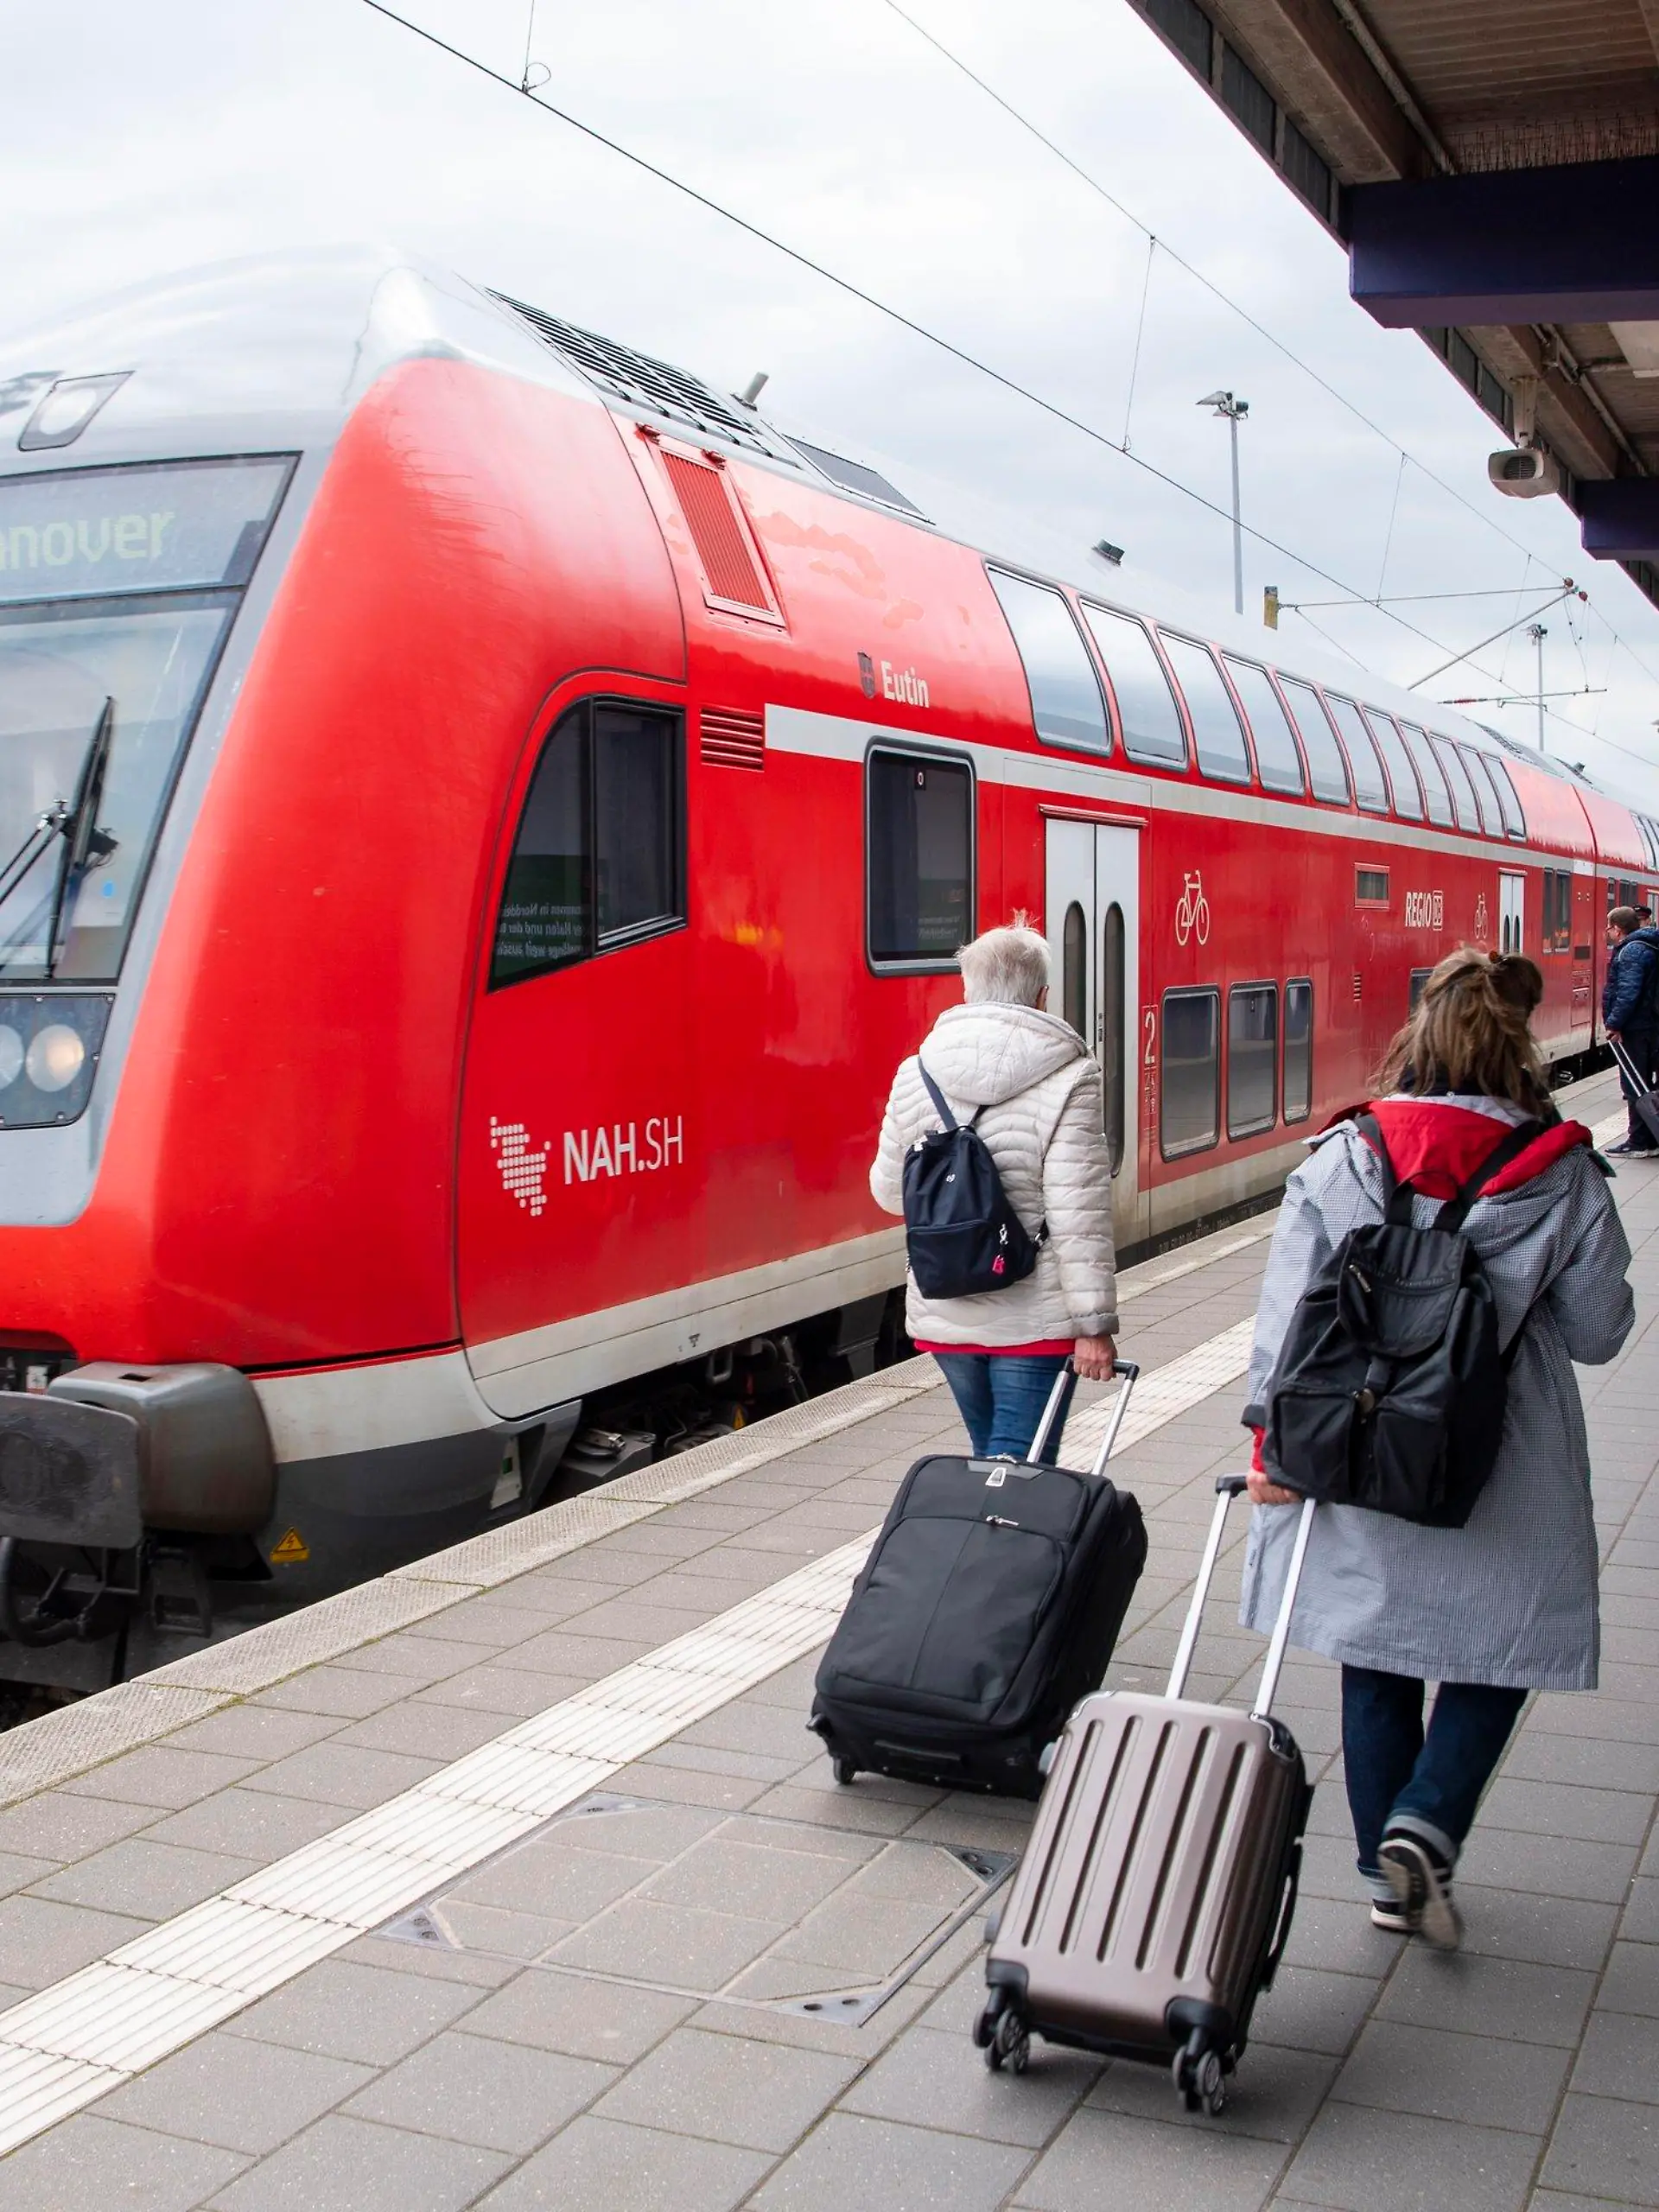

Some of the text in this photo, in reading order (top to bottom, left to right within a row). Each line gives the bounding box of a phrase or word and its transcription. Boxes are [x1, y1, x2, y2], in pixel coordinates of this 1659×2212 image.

[880, 660, 930, 709] Eutin
[1405, 891, 1432, 928] REGIO
[1144, 1010, 1156, 1065] 2
[563, 1115, 683, 1185] NAH.SH
